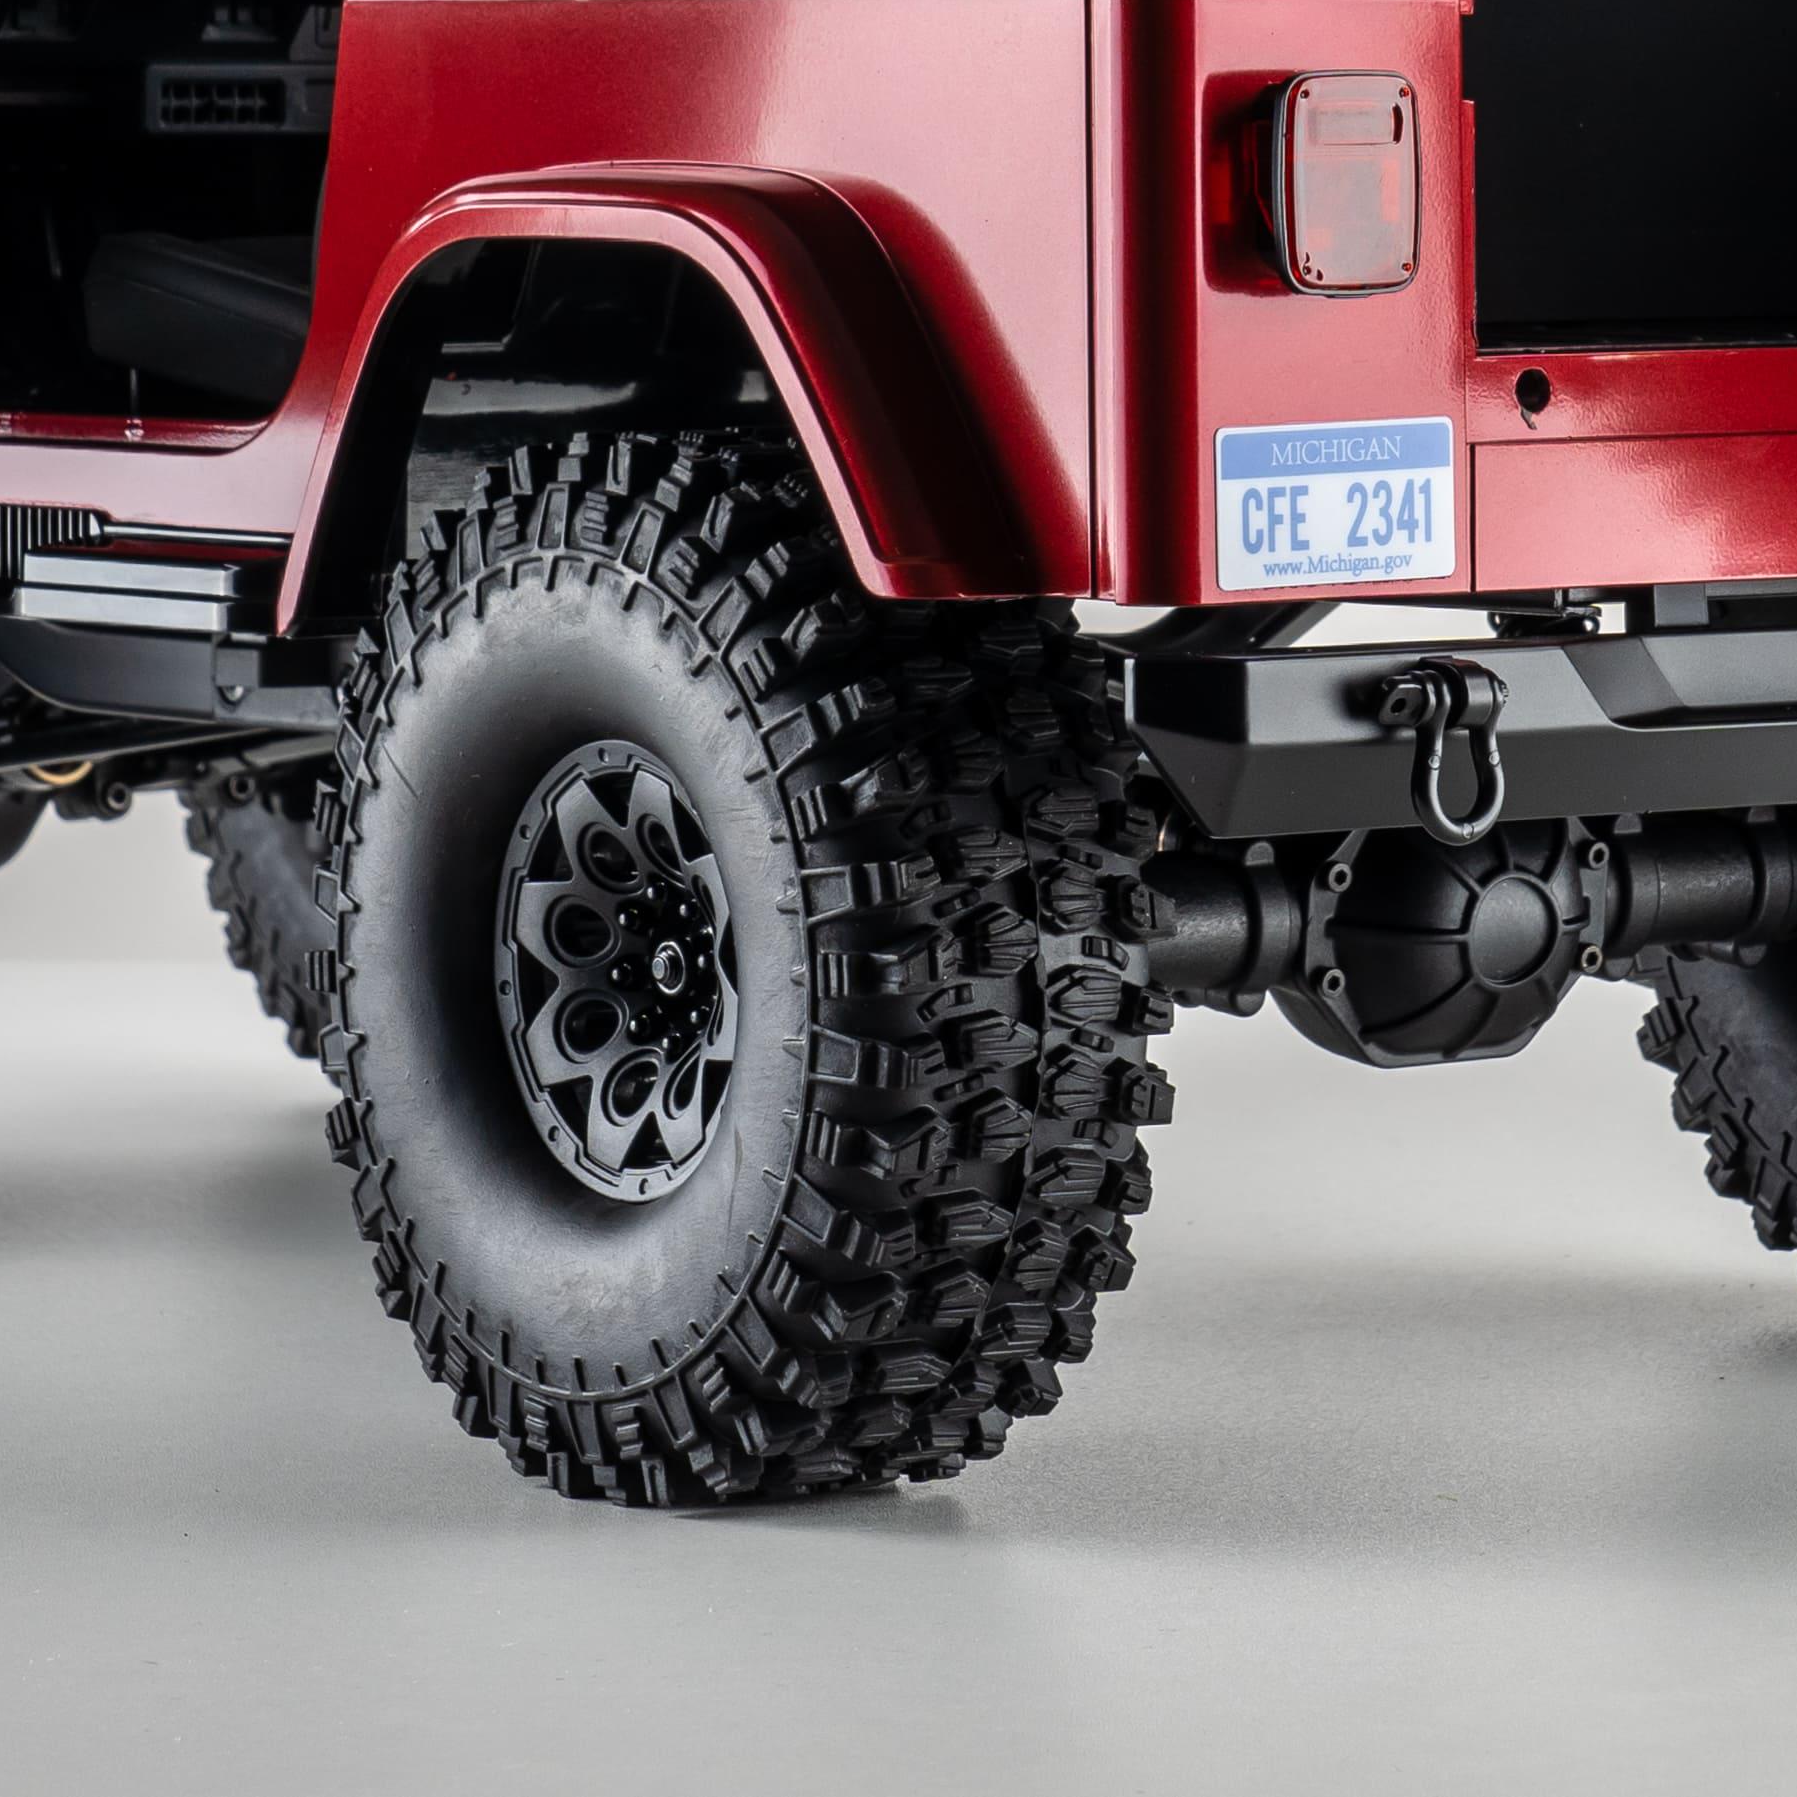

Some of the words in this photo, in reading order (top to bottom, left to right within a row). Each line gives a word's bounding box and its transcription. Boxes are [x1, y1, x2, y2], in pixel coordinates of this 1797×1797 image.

[1270, 435, 1403, 467] MICHIGAN
[1241, 484, 1310, 554] CFE
[1346, 477, 1432, 548] 2341
[1262, 553, 1413, 577] www.Michigan.gov
